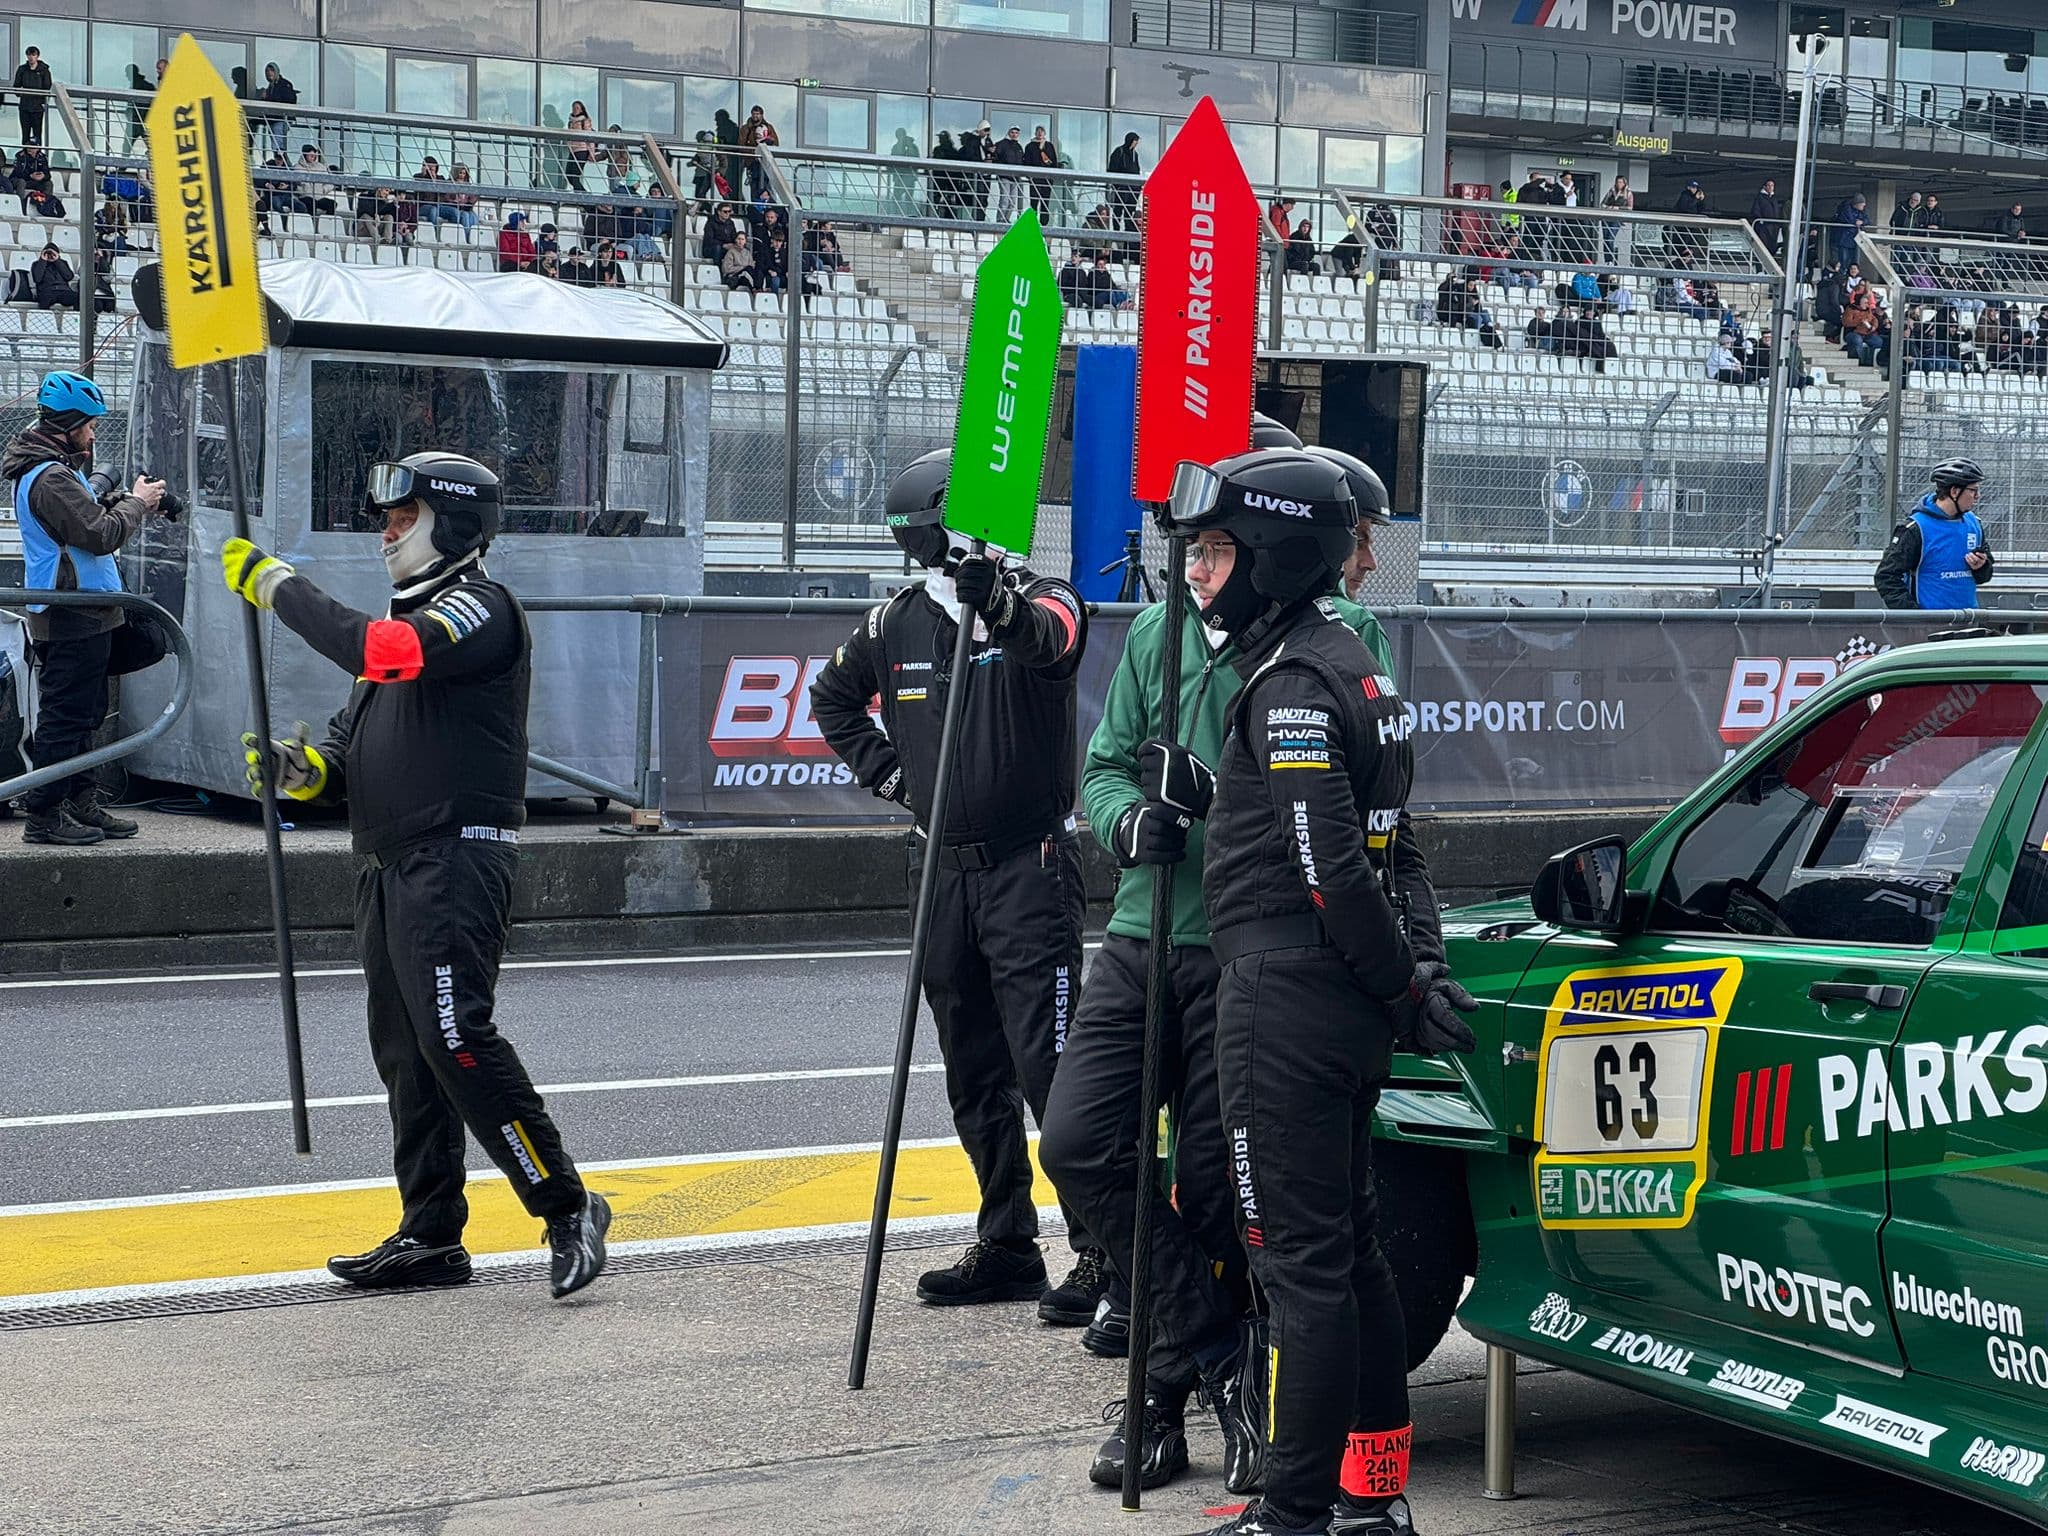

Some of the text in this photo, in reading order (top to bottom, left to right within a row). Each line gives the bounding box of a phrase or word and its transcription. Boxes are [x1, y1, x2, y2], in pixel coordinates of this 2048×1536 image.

[1611, 0, 1737, 46] POWER
[1616, 131, 1669, 152] Ausgang
[173, 103, 214, 294] KÄRCHER
[989, 275, 1032, 473] WEMPE
[430, 478, 477, 497] uvex
[1243, 492, 1313, 519] uvex
[902, 662, 932, 671] PARKSIDE
[1267, 707, 1329, 723] SANDTLER
[1268, 729, 1328, 742] HWA
[1270, 750, 1330, 762] KÄRCHER
[1294, 801, 1320, 886] PARKSIDE
[435, 965, 463, 1050] PARKSIDE
[1055, 966, 1069, 1053] PARKSIDE
[1579, 983, 1705, 1012] RAVENOL
[1594, 1042, 1659, 1141] 63
[501, 1122, 542, 1185] KÄRCHER
[1234, 1126, 1259, 1219] PARKSIDE
[1575, 1168, 1676, 1214] DEKRA
[1717, 1253, 1875, 1337] PROTEC
[1892, 1271, 2024, 1337] bluechem
[1612, 1331, 1695, 1375] RONAL
[1716, 1359, 1805, 1402] SANDTLER
[1836, 1406, 1924, 1445] RAVENOL
[1365, 1457, 1399, 1476] 24h
[1367, 1476, 1400, 1493] 126
